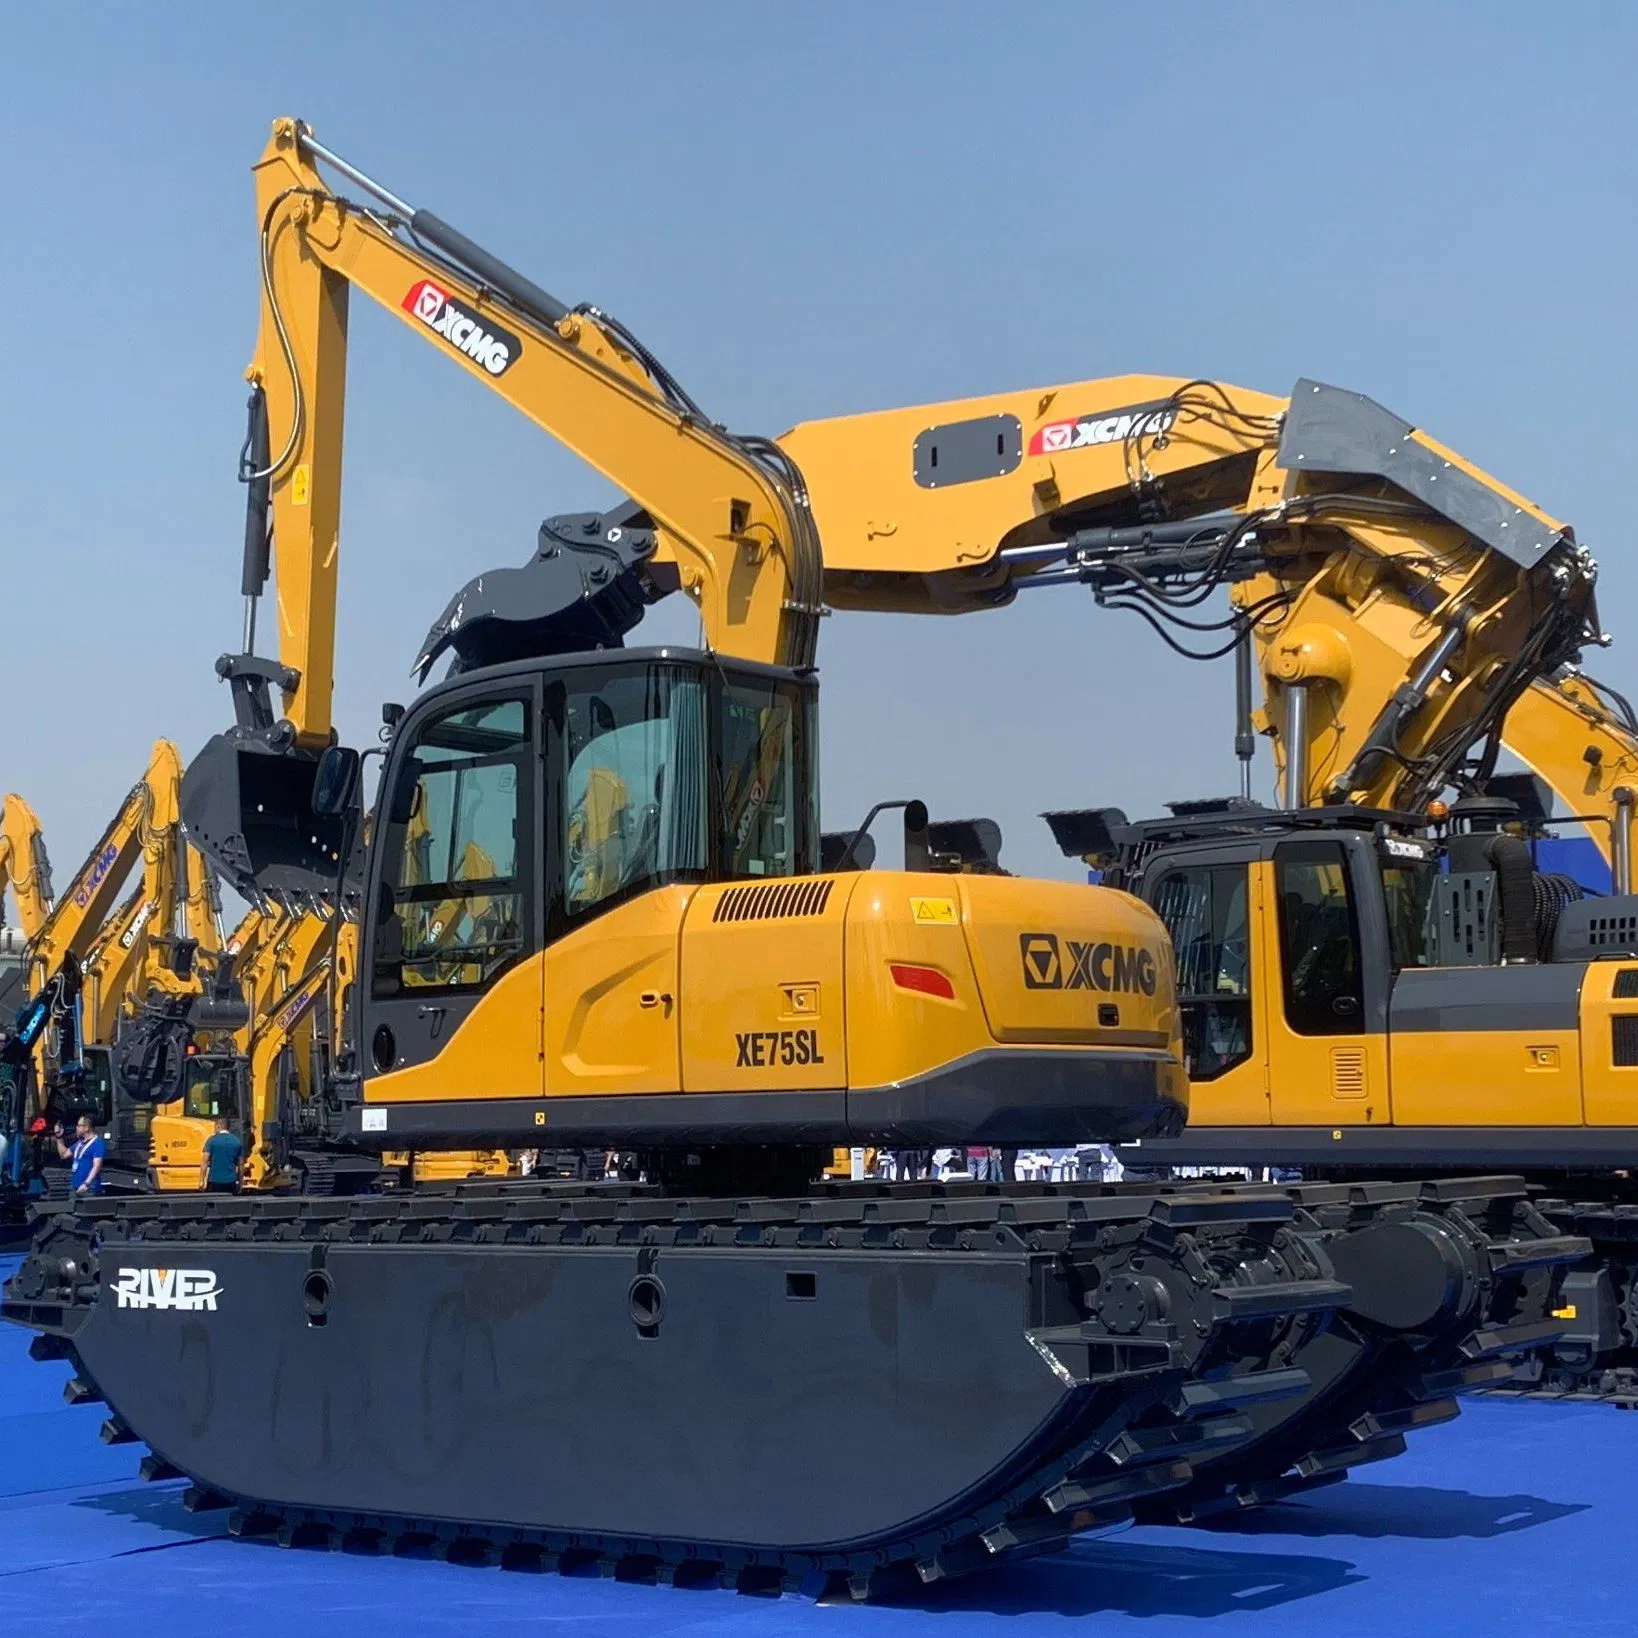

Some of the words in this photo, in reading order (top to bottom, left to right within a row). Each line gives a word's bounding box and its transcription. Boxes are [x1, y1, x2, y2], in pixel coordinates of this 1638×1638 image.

[432, 304, 509, 374] XCMG
[1064, 941, 1157, 996] XCMG
[736, 1030, 825, 1067] XE75SL
[112, 1268, 223, 1311] RIVER
